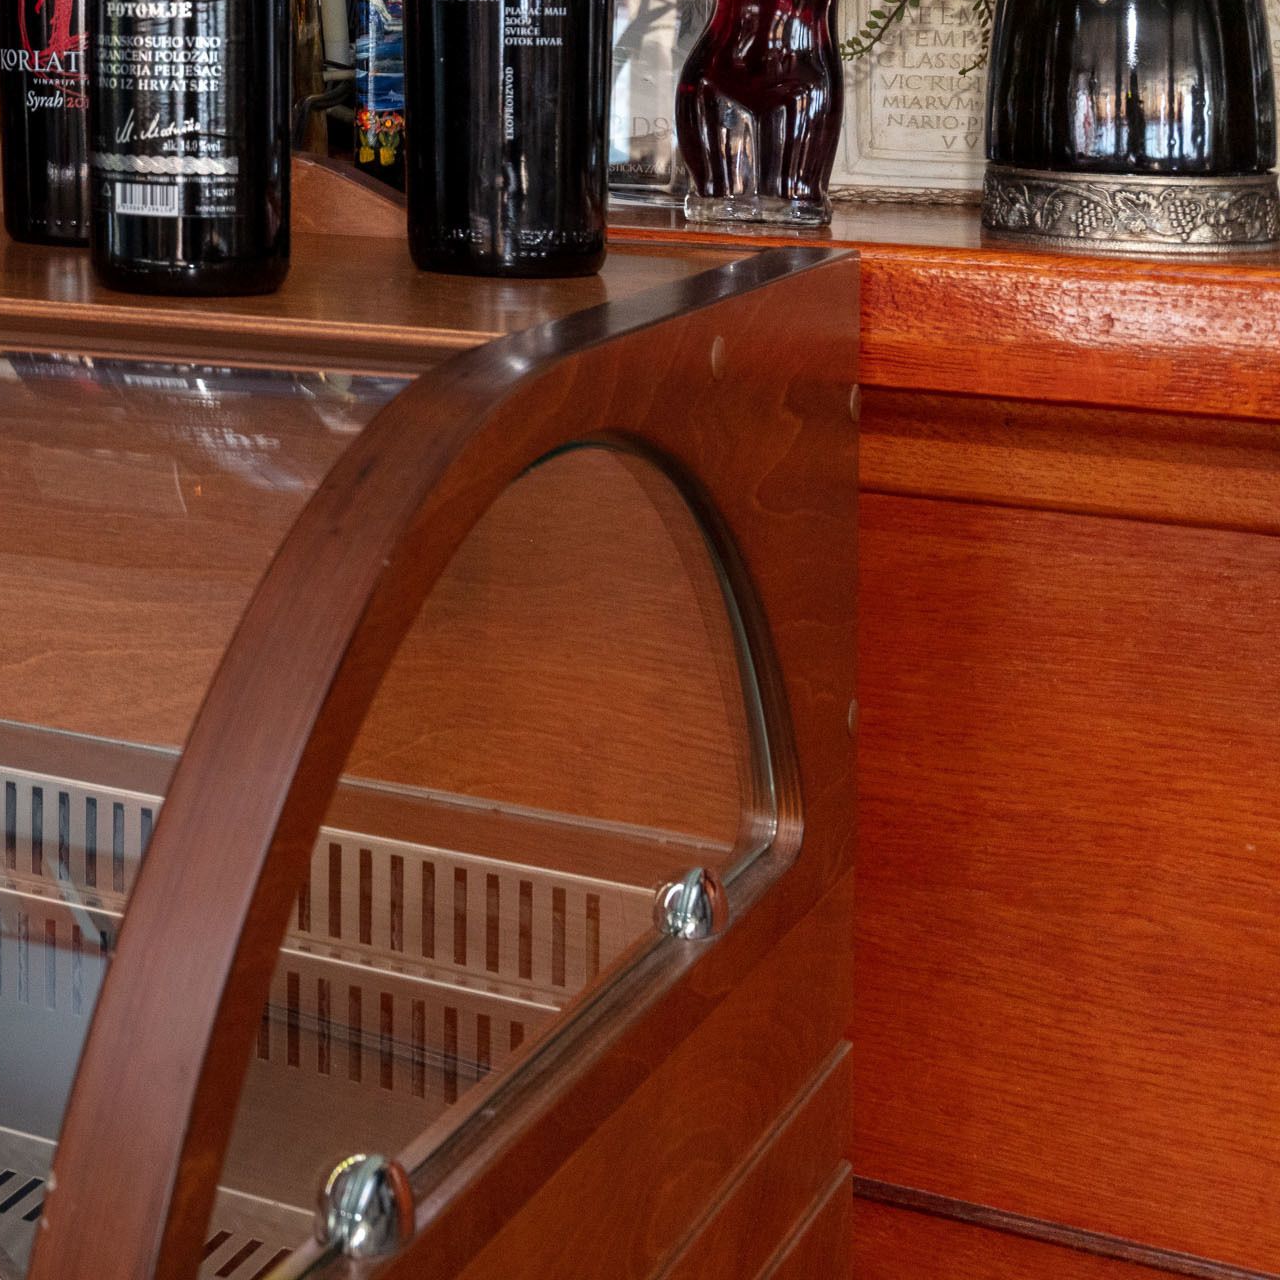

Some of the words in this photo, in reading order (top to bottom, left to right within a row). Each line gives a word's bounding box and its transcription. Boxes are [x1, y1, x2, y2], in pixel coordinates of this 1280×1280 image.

[107, 2, 193, 18] POTOMJE
[505, 7, 542, 16] PLAAC
[544, 7, 567, 16] MALI
[505, 16, 532, 26] 2009
[504, 25, 540, 36] SVIRČE
[144, 36, 184, 48] SUHO
[186, 36, 220, 48] VINO
[504, 37, 534, 46] OTOK
[536, 38, 564, 46] HVAR
[0, 48, 81, 72] KORLAT
[154, 49, 218, 64] POLOŽAJI
[154, 63, 222, 78] PELJEŠAC
[120, 78, 134, 90] IZ
[138, 79, 220, 92] HRVATSKE
[26, 90, 64, 112] Syrah
[504, 66, 514, 140] EKOPROIZVOD
